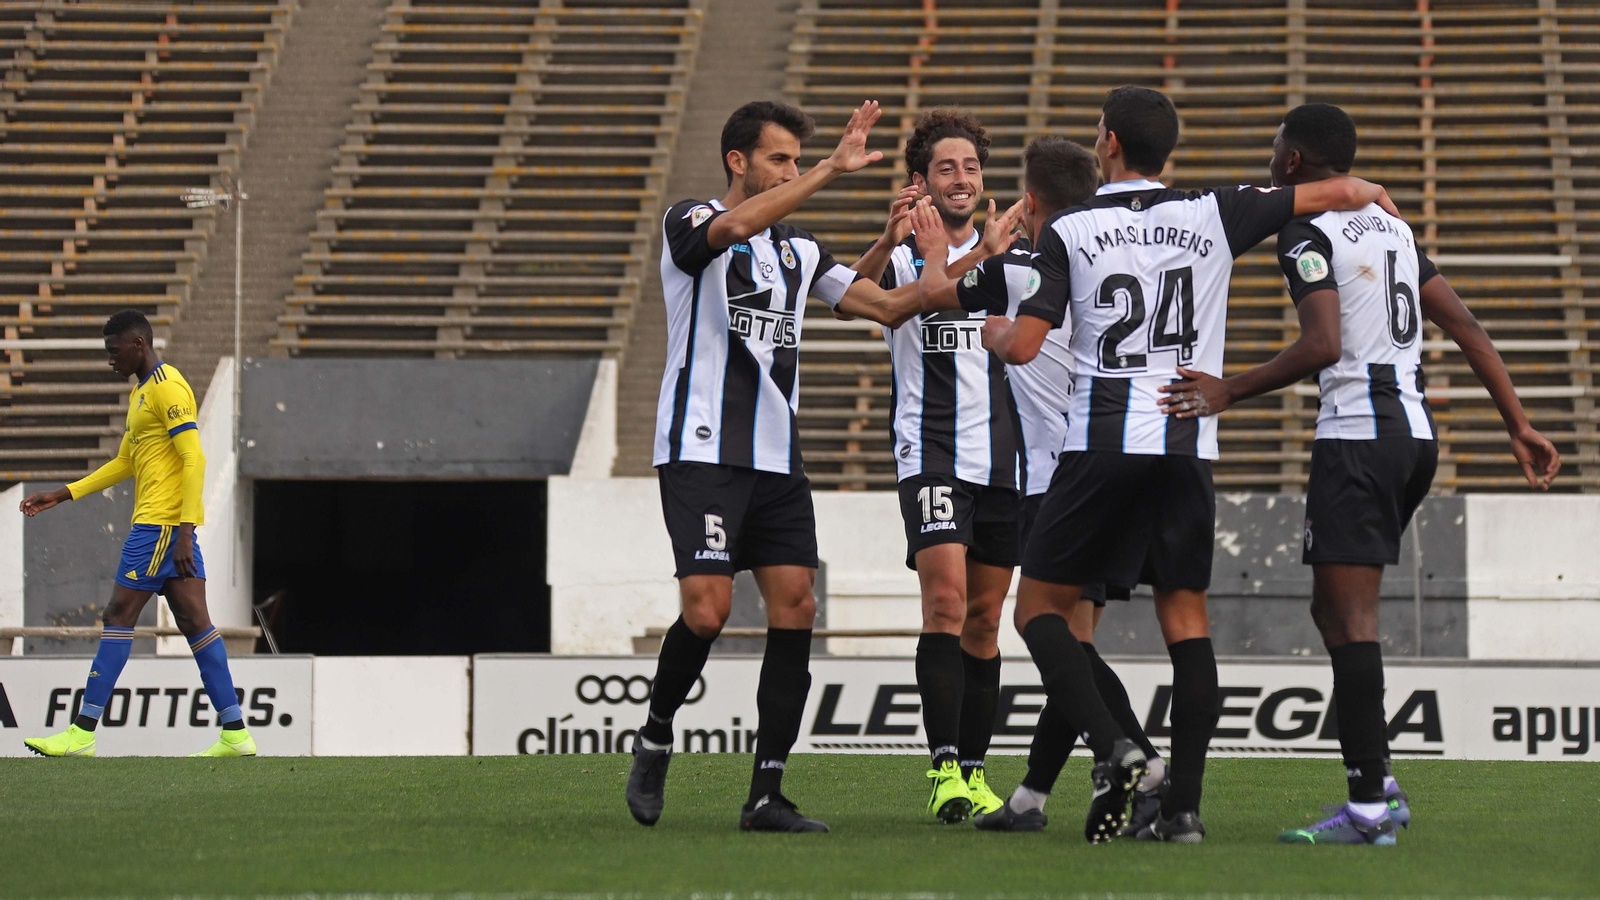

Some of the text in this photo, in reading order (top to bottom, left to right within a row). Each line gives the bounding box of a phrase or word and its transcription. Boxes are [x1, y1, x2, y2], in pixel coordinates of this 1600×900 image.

[1384, 249, 1417, 349] 6
[1095, 266, 1198, 373] 24
[917, 486, 954, 523] 15
[704, 513, 727, 551] 5
[920, 521, 957, 534] LEGEA
[694, 549, 730, 562] LEGEA
[1491, 705, 1600, 756] apy
